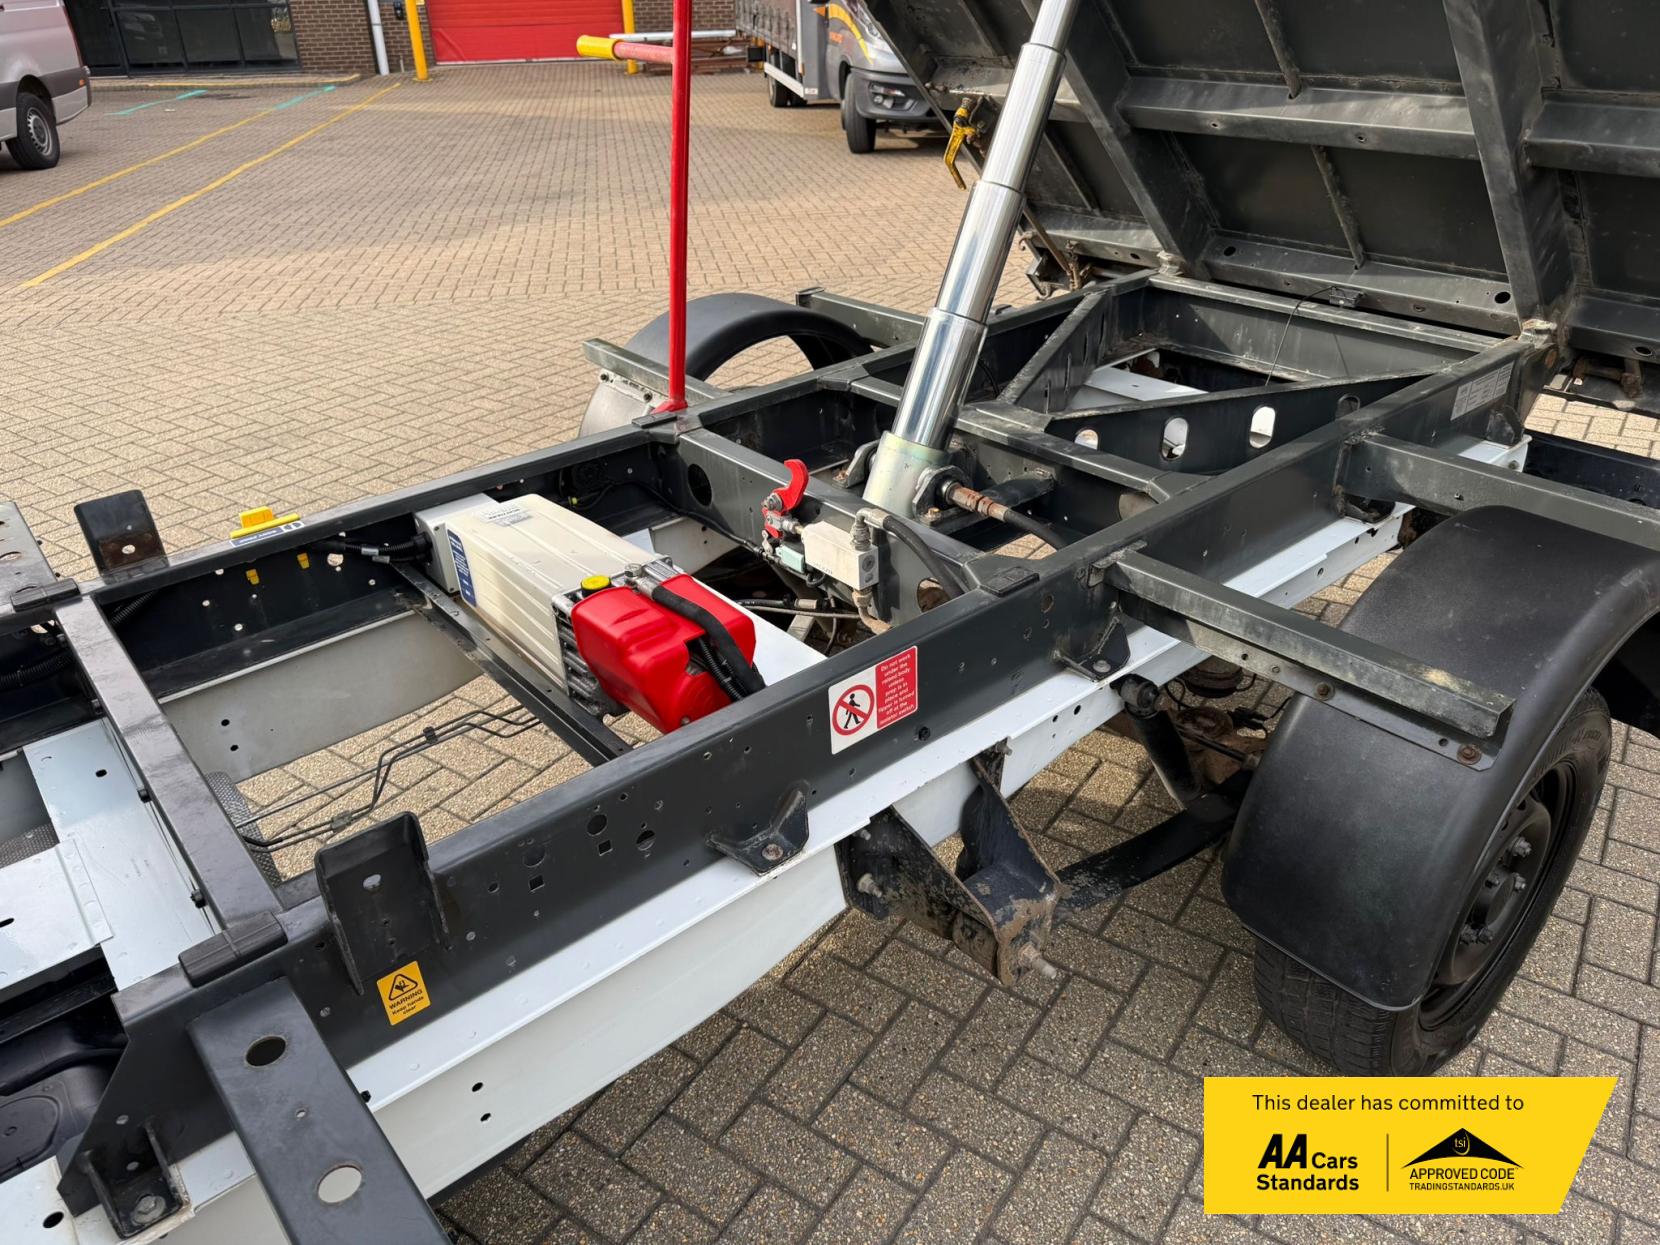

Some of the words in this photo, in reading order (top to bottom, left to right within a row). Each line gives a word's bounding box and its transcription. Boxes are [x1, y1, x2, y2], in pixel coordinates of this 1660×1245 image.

[884, 666, 898, 677] under
[389, 988, 423, 1009] WARNING
[392, 1005, 407, 1015] Keep
[407, 996, 424, 1007] hands
